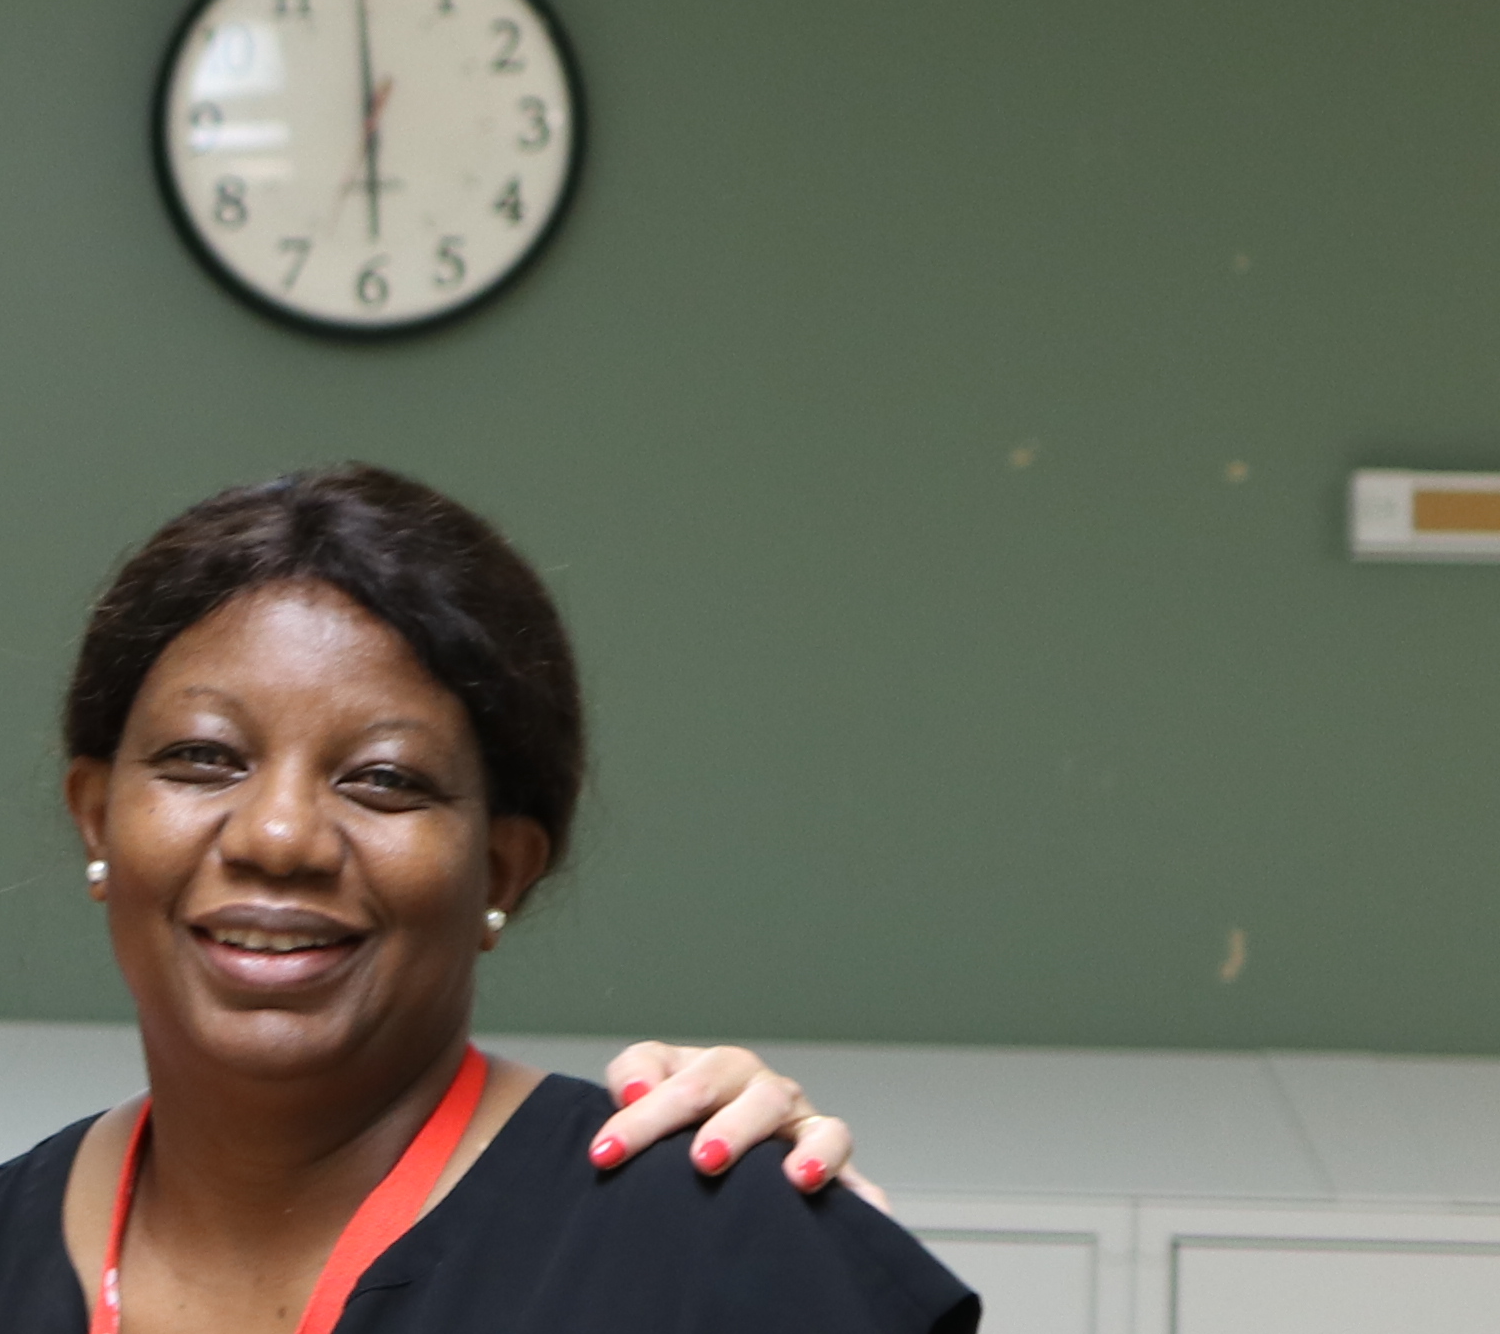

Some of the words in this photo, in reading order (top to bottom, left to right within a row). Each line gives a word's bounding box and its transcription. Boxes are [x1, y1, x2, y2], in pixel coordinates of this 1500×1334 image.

[489, 18, 525, 73] 2
[517, 95, 551, 152] 3
[214, 175, 248, 228] 8
[492, 175, 524, 226] 4
[277, 235, 313, 294] 7
[356, 253, 390, 306] 6
[434, 233, 467, 288] 5
